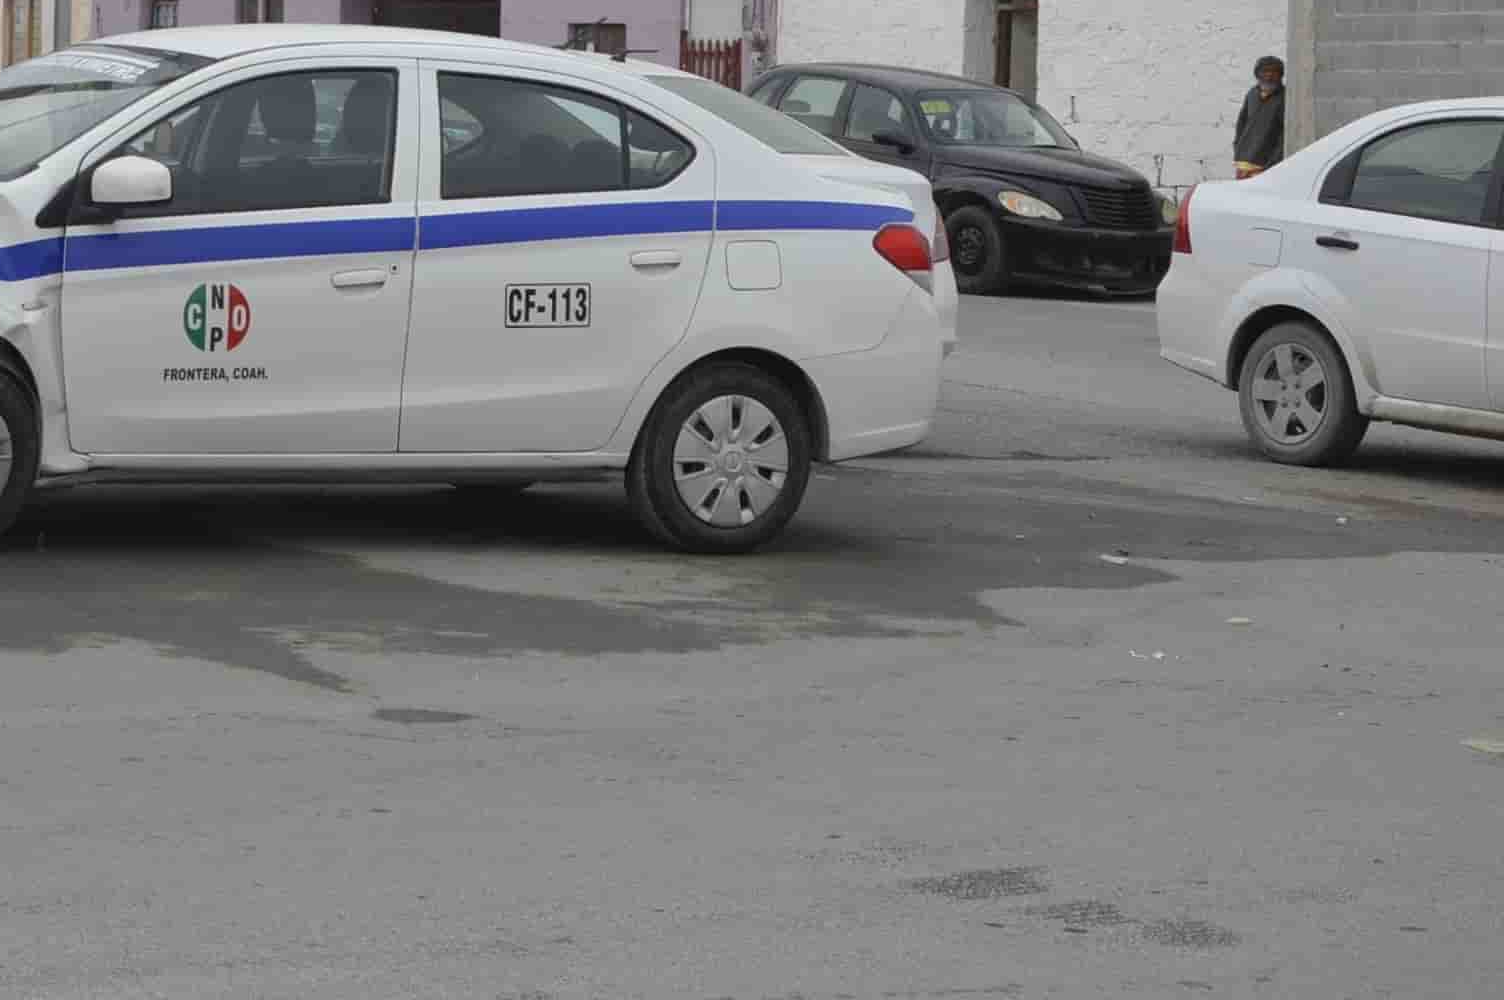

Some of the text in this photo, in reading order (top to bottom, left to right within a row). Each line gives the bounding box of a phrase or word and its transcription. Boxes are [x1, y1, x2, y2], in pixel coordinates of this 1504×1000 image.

[508, 287, 587, 323] CF-113
[163, 367, 269, 383] FRONTERA, COAH.
